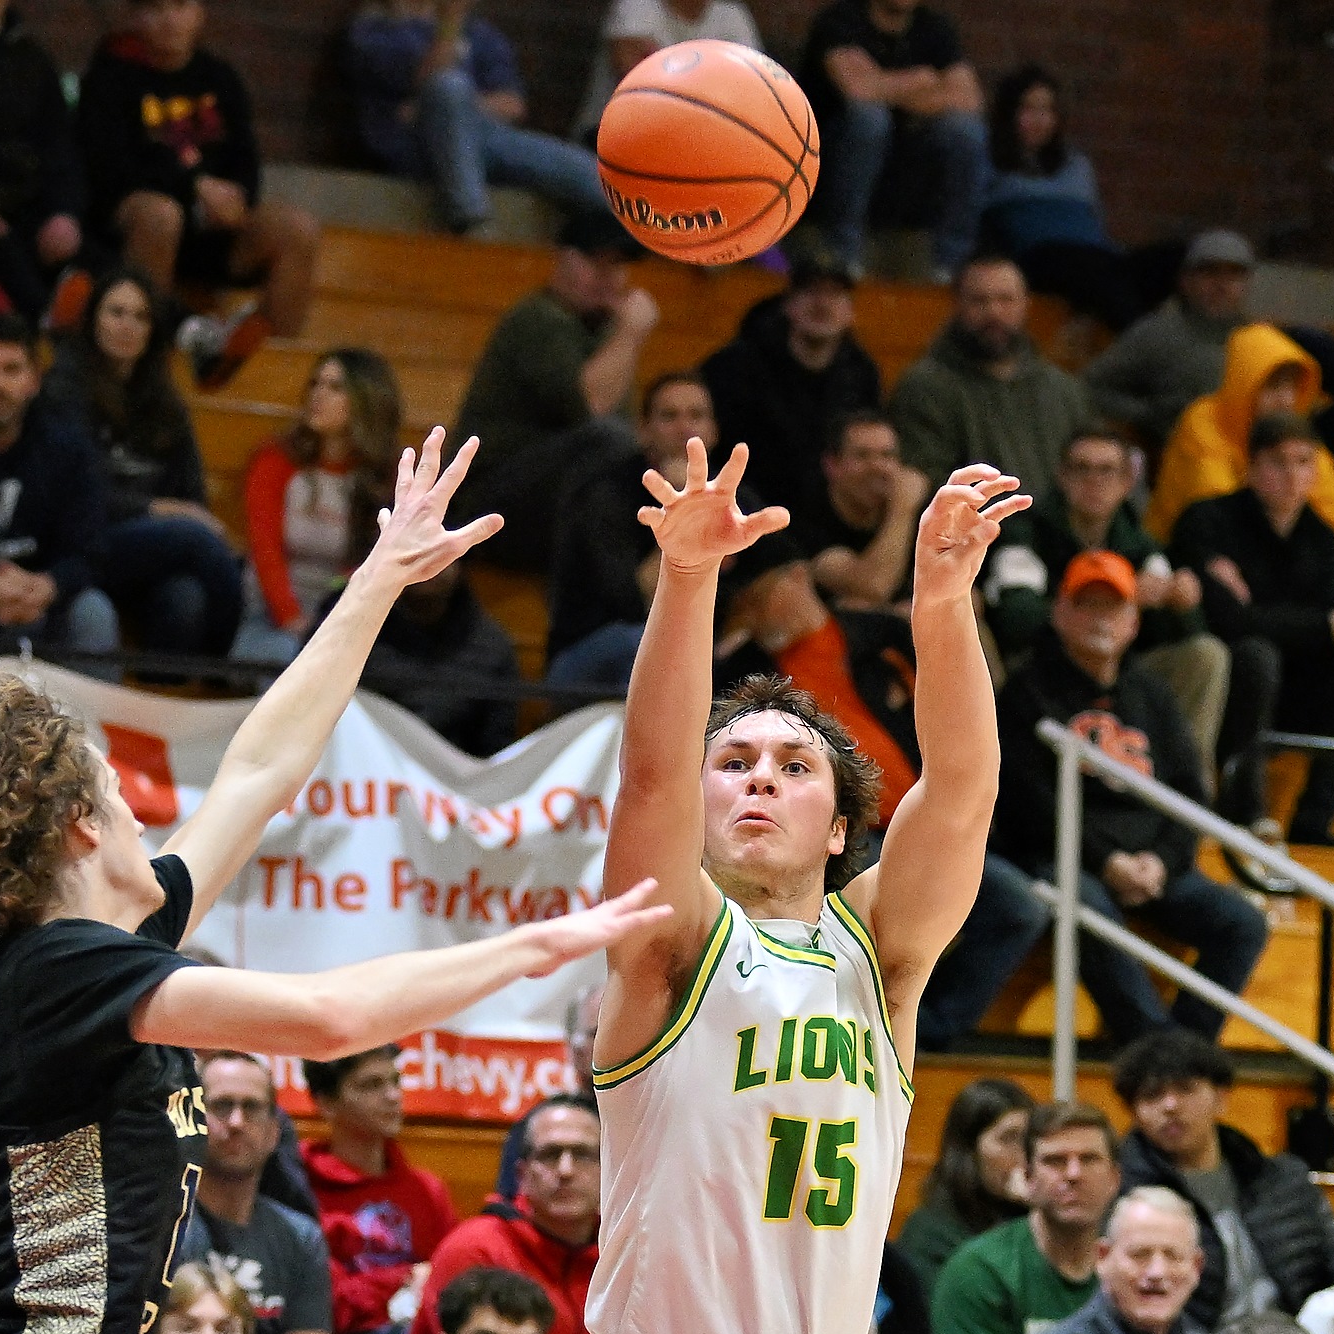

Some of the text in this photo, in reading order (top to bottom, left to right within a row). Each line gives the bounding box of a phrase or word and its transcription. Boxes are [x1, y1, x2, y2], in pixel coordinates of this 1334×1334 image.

[541, 786, 608, 833] On
[257, 855, 367, 912] The
[763, 1112, 859, 1231] 15
